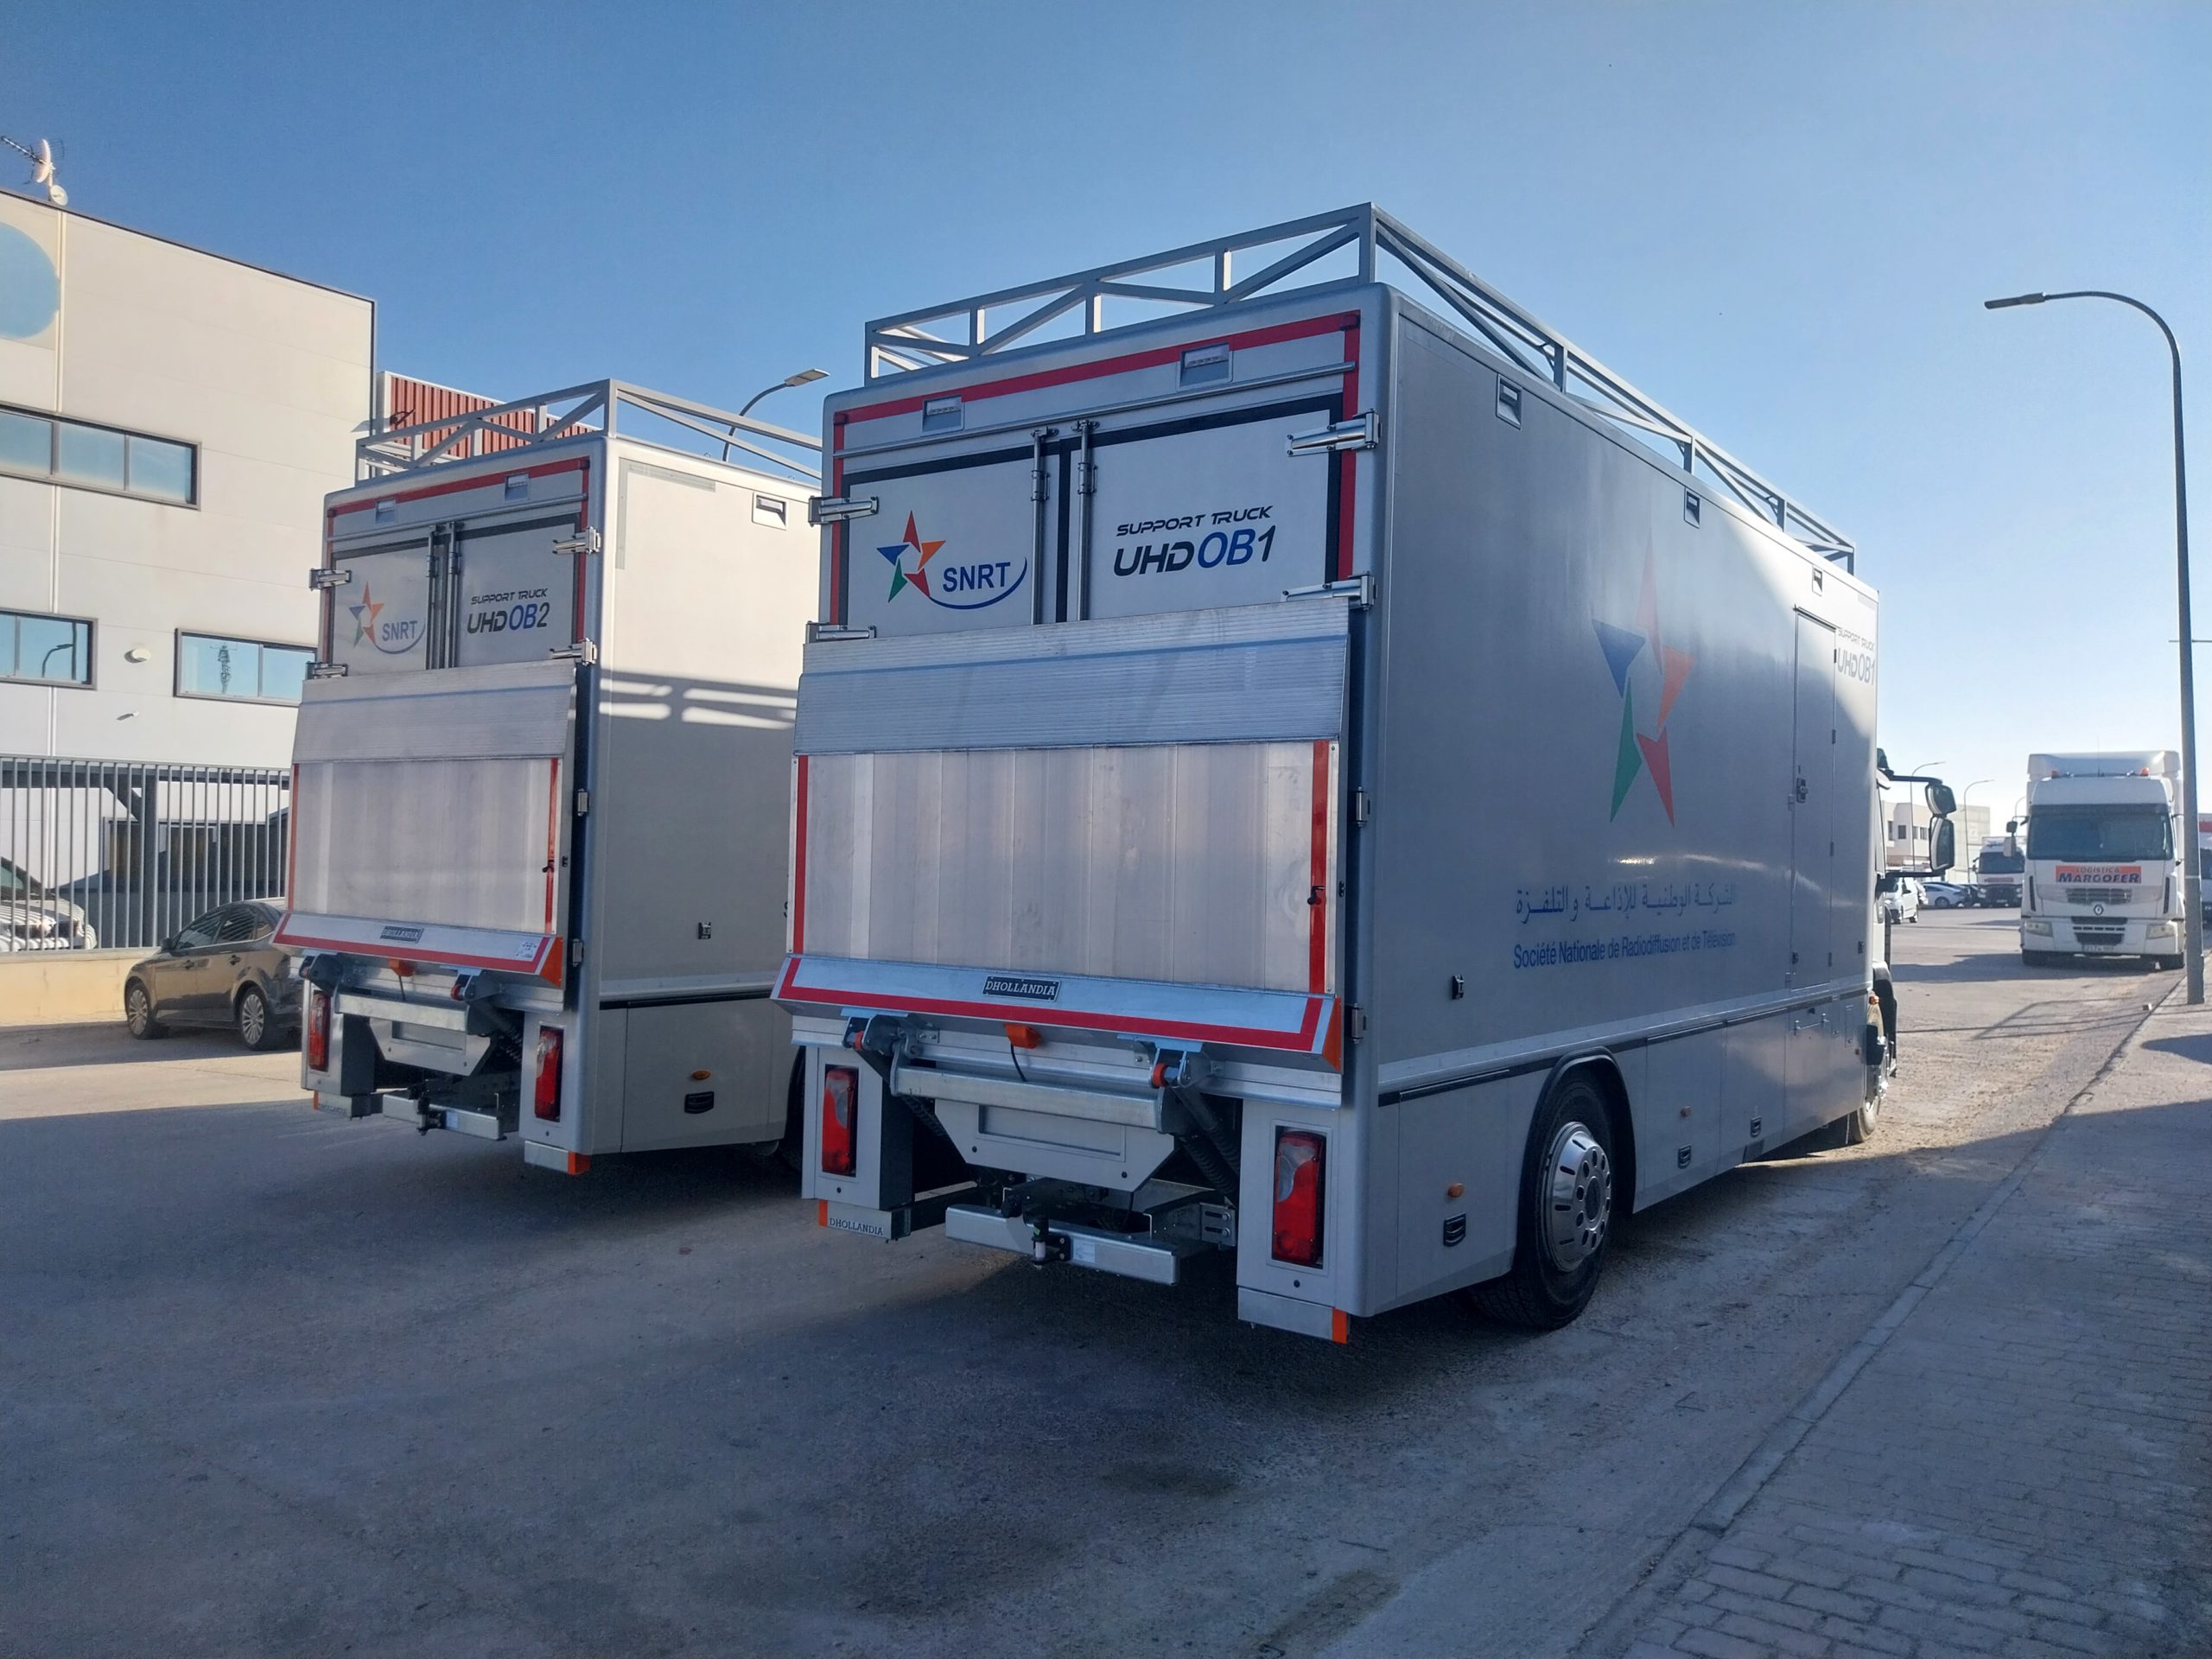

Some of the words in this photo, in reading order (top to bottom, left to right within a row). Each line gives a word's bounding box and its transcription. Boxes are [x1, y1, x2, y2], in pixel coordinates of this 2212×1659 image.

[1116, 514, 1206, 537] SUPPORT
[1211, 505, 1274, 524] TRUCK
[943, 562, 1011, 592] SNRT
[471, 591, 516, 605] SUPPORT
[518, 588, 548, 601] TRUCK
[382, 620, 417, 641] SNRT
[1514, 940, 1557, 969] Société
[1559, 938, 1605, 963] Nationale
[1607, 938, 1620, 959] de
[1622, 934, 1681, 957] Radiodiffusion
[1681, 934, 1690, 951] et
[1691, 932, 1700, 950] de
[985, 981, 1056, 995] DHOLLANDIA
[830, 1217, 883, 1236] DHOLLANDIA
